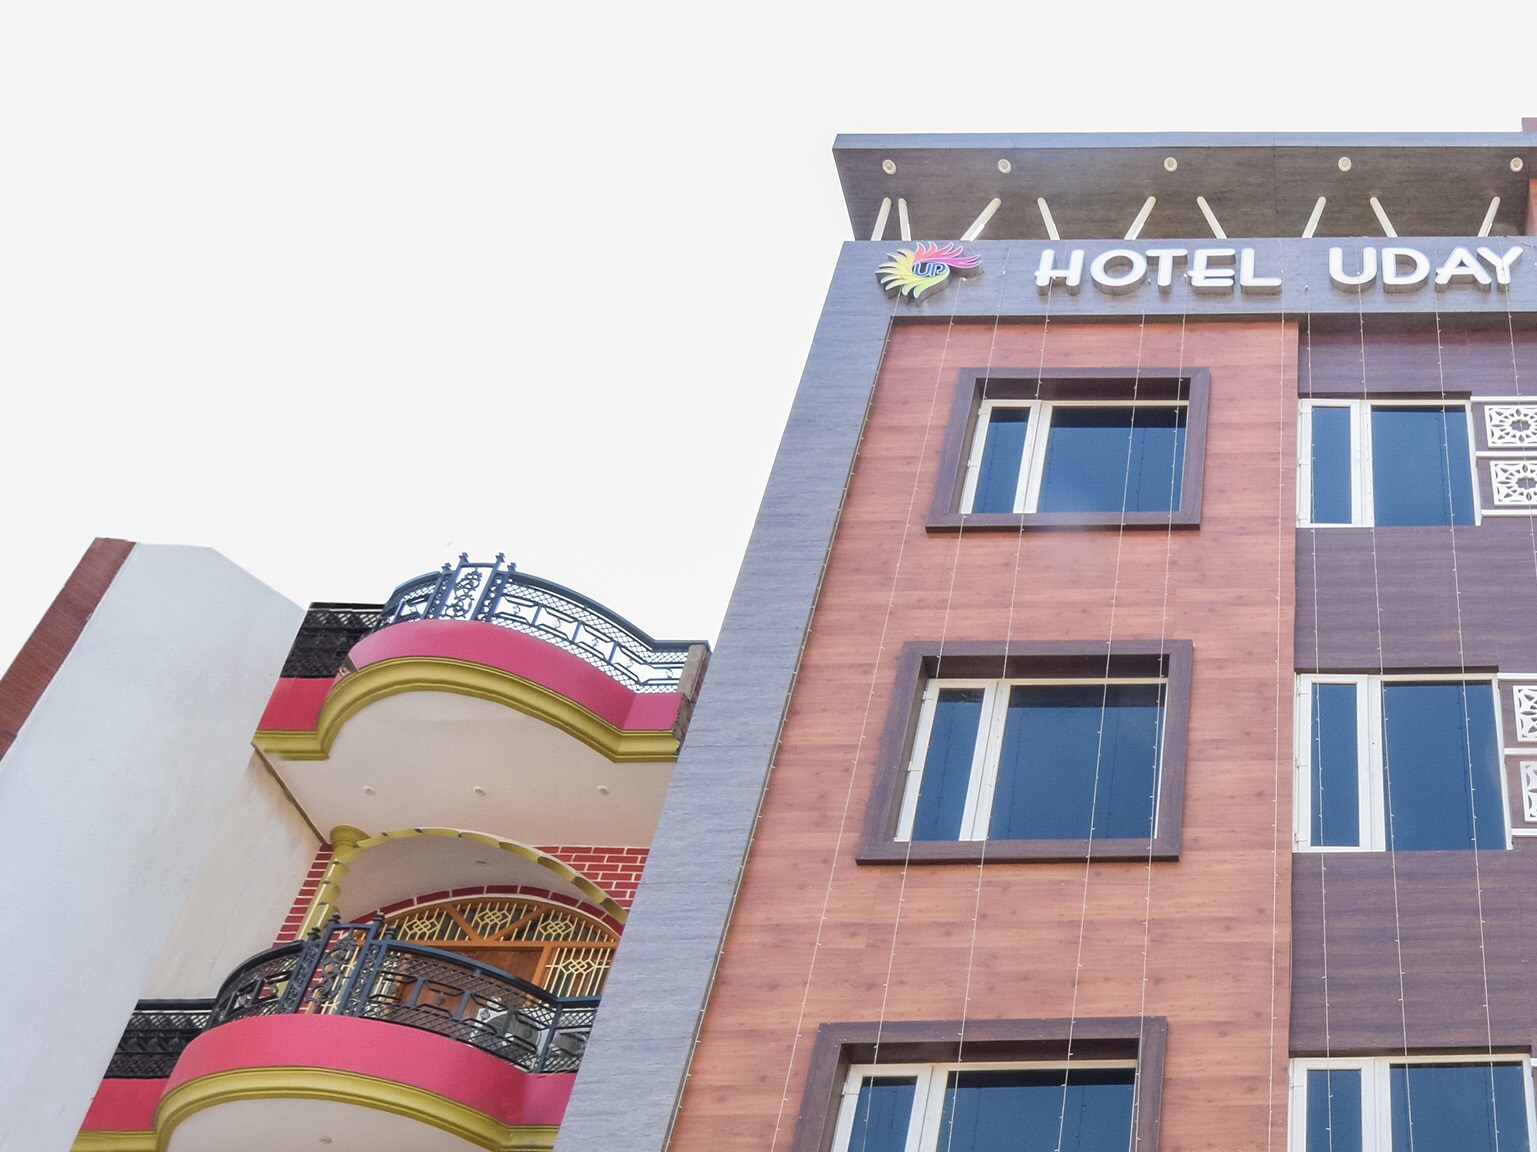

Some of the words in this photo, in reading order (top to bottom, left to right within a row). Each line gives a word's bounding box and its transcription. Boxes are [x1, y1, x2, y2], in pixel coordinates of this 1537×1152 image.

[912, 261, 944, 277] UP
[1034, 246, 1284, 297] HOTEL
[1328, 244, 1524, 294] UDAY
